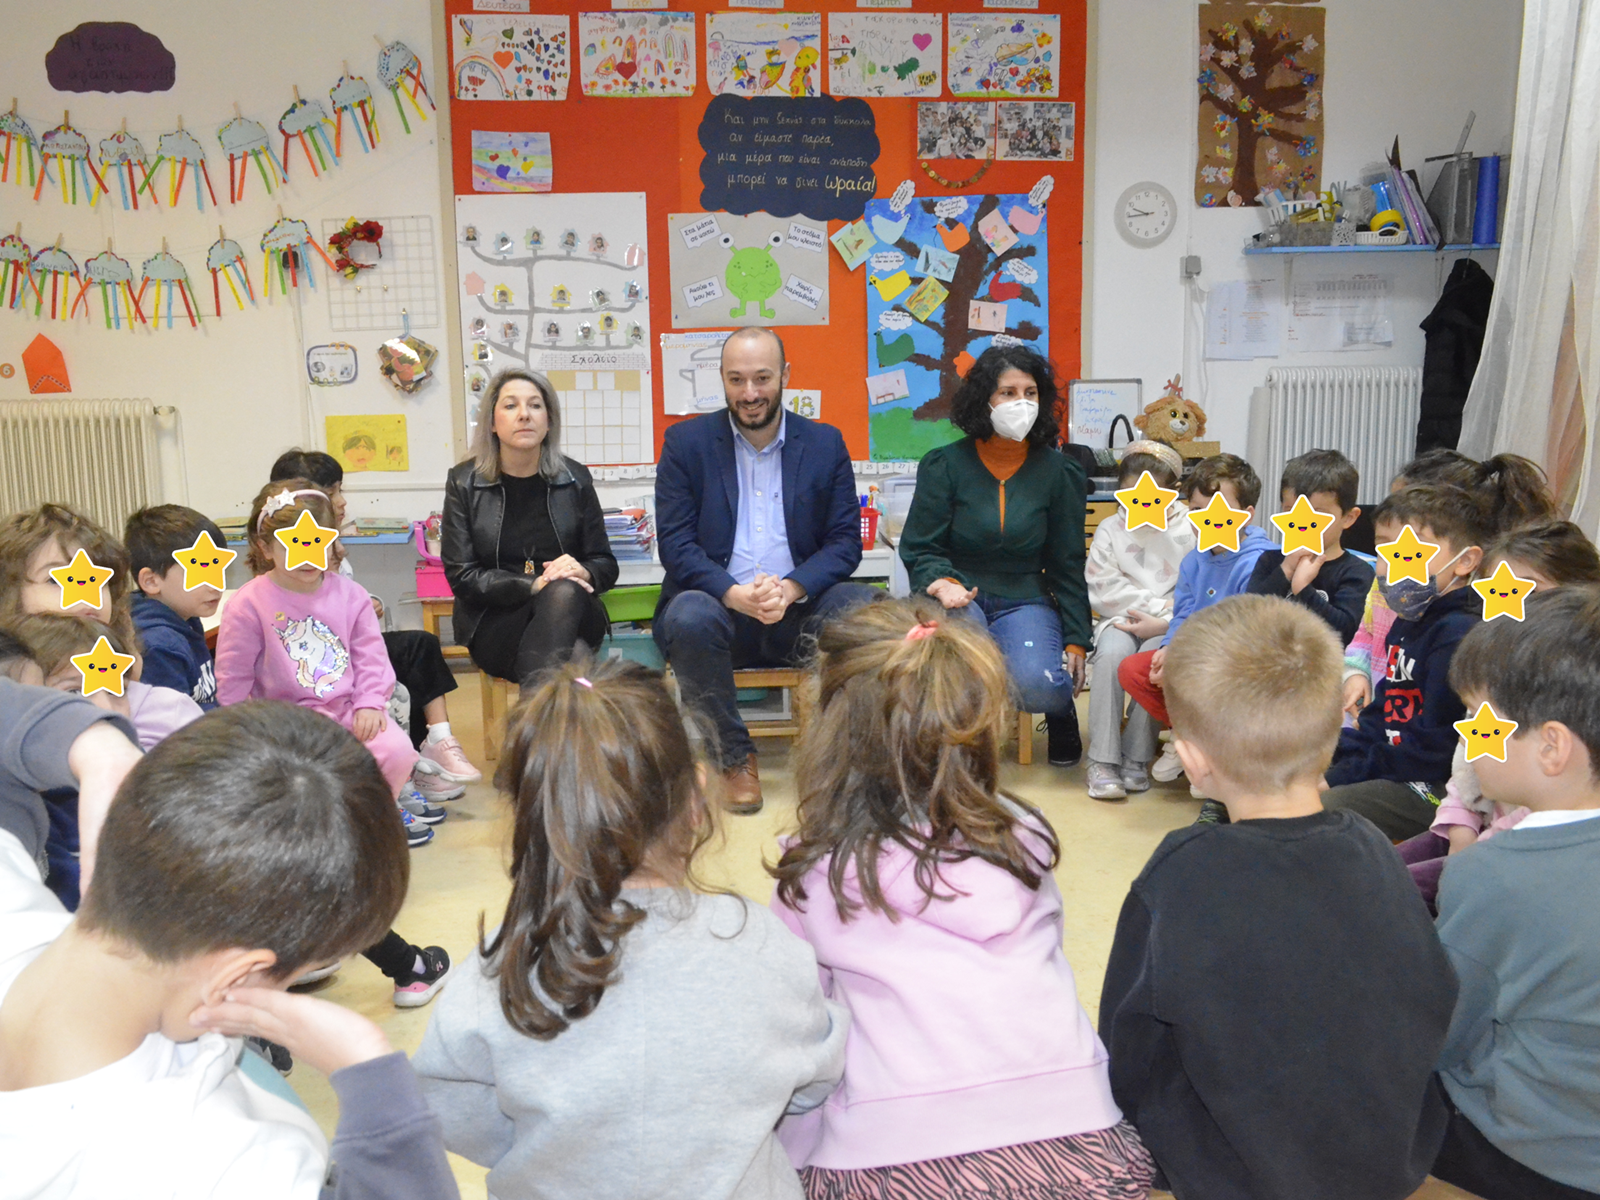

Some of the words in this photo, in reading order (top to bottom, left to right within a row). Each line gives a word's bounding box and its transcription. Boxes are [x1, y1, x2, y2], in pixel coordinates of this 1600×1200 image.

[724, 108, 745, 124] Και
[753, 116, 769, 126] μην
[810, 115, 826, 125] στα
[729, 132, 743, 142] αν
[754, 130, 793, 146] είμαστε
[801, 132, 834, 149] παρέα,
[717, 152, 737, 164] μια
[745, 149, 772, 164] μέρα
[778, 154, 794, 164] που
[798, 151, 820, 165] είναι
[829, 156, 868, 168] ανάποδη
[727, 172, 766, 190] μπορεί
[775, 175, 788, 186] να
[795, 176, 819, 189] γίνει
[684, 228, 696, 236] Στα
[696, 219, 714, 231] μάτια
[698, 226, 715, 238] κοιτώ
[793, 225, 801, 233] Το
[802, 229, 820, 239] στόμα
[787, 233, 799, 241] μου
[800, 237, 822, 248] κλειστό
[796, 281, 813, 294] Χωρίς
[693, 294, 704, 302] μου
[571, 353, 617, 365] Σχολείο
[696, 361, 718, 369] ημέρα
[3, 365, 11, 376] 6
